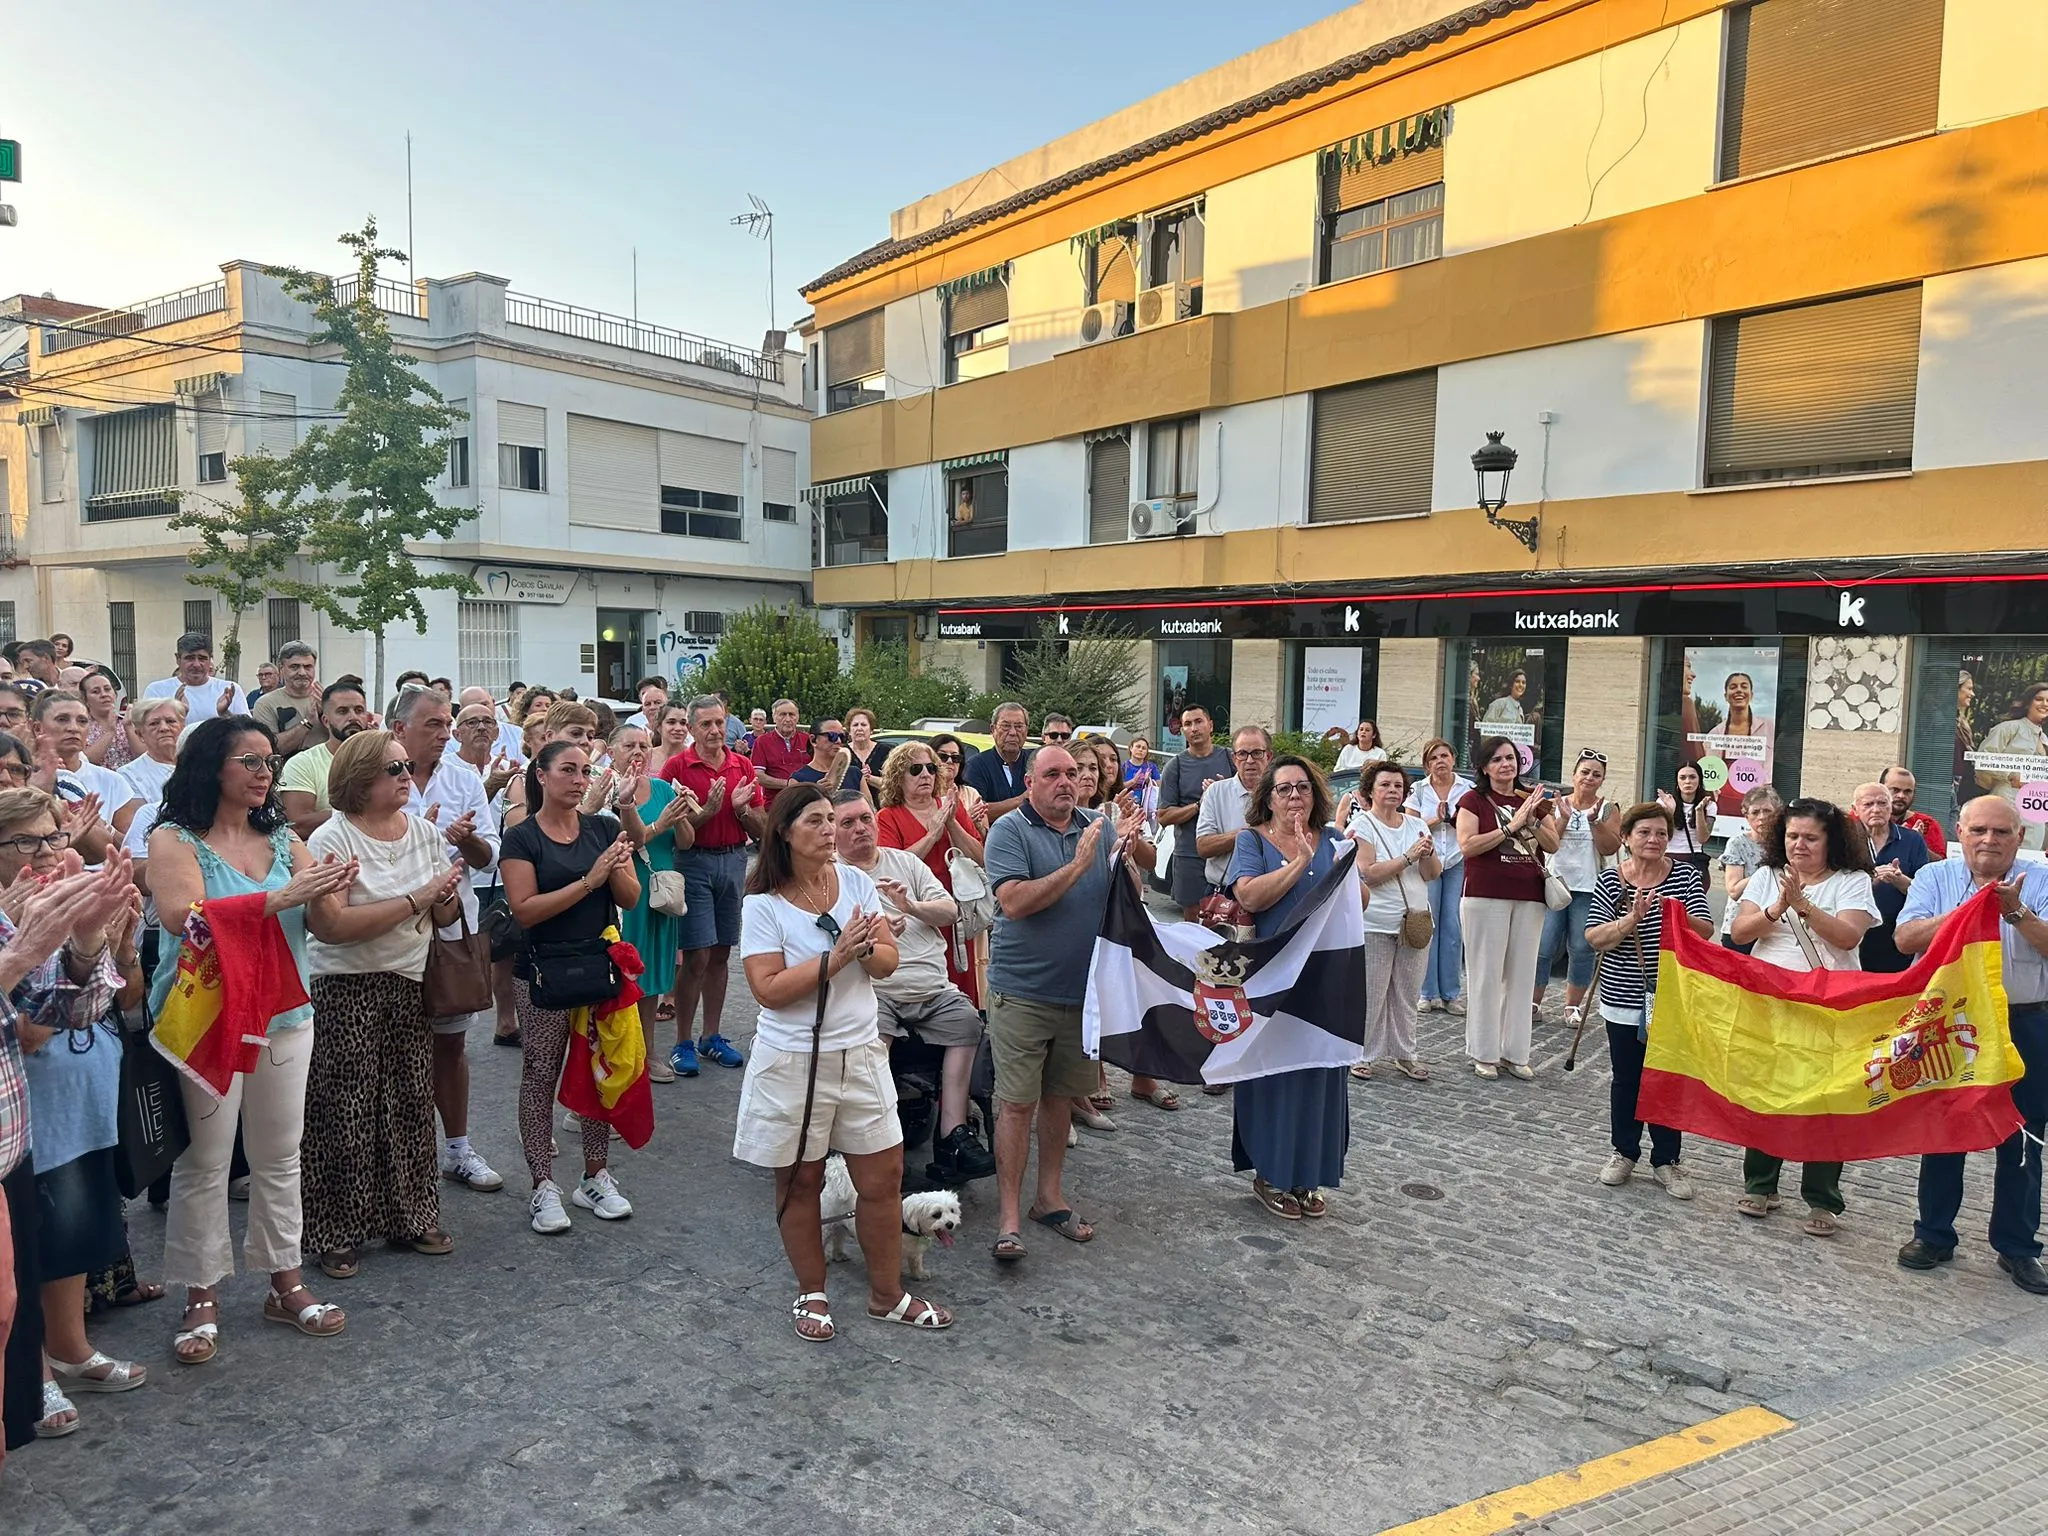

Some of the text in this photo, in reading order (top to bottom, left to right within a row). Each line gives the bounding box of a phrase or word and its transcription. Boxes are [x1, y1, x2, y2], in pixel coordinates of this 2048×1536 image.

[1839, 591, 1865, 627] k
[1161, 618, 1222, 634] kutxabank
[1344, 605, 1360, 632] k
[1515, 608, 1620, 629] kutxabank
[940, 622, 981, 635] kutxabank
[2028, 790, 2048, 798] HAST
